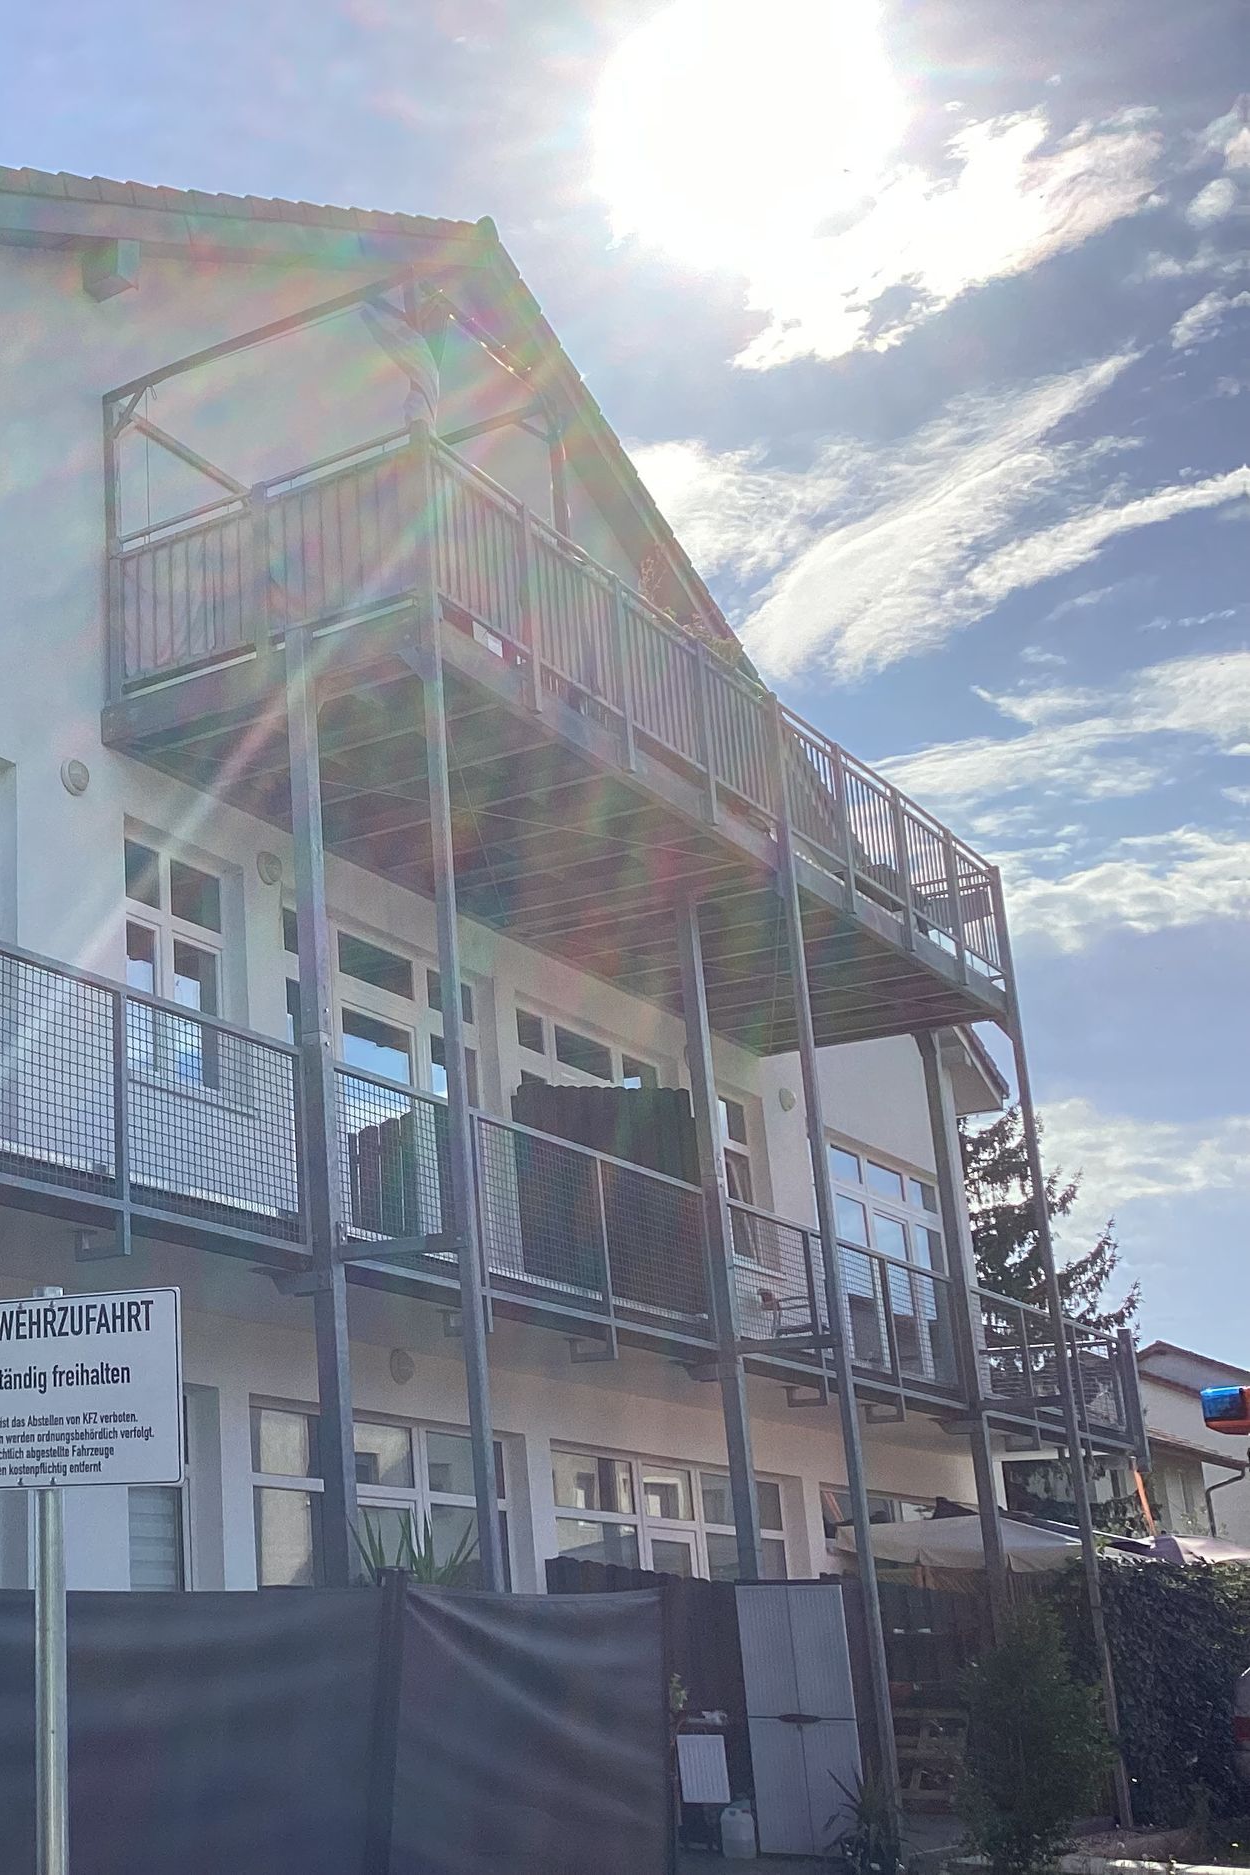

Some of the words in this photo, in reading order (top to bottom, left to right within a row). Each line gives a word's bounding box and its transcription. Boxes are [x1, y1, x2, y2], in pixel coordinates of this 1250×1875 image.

[52, 1362, 130, 1387] freihalten
[0, 1417, 10, 1428] ist
[11, 1416, 25, 1427] das
[28, 1414, 64, 1426] Abstellen
[66, 1416, 81, 1425] von
[83, 1413, 98, 1424] KFZ
[100, 1412, 138, 1424] verboten.
[6, 1432, 35, 1443] werden
[37, 1429, 118, 1444] ordnungsbehördlich
[26, 1448, 70, 1461] abgestellte
[72, 1446, 114, 1458] Fahrzeuge
[9, 1463, 67, 1476] kostenpflichtig
[69, 1462, 101, 1473] entfernt
